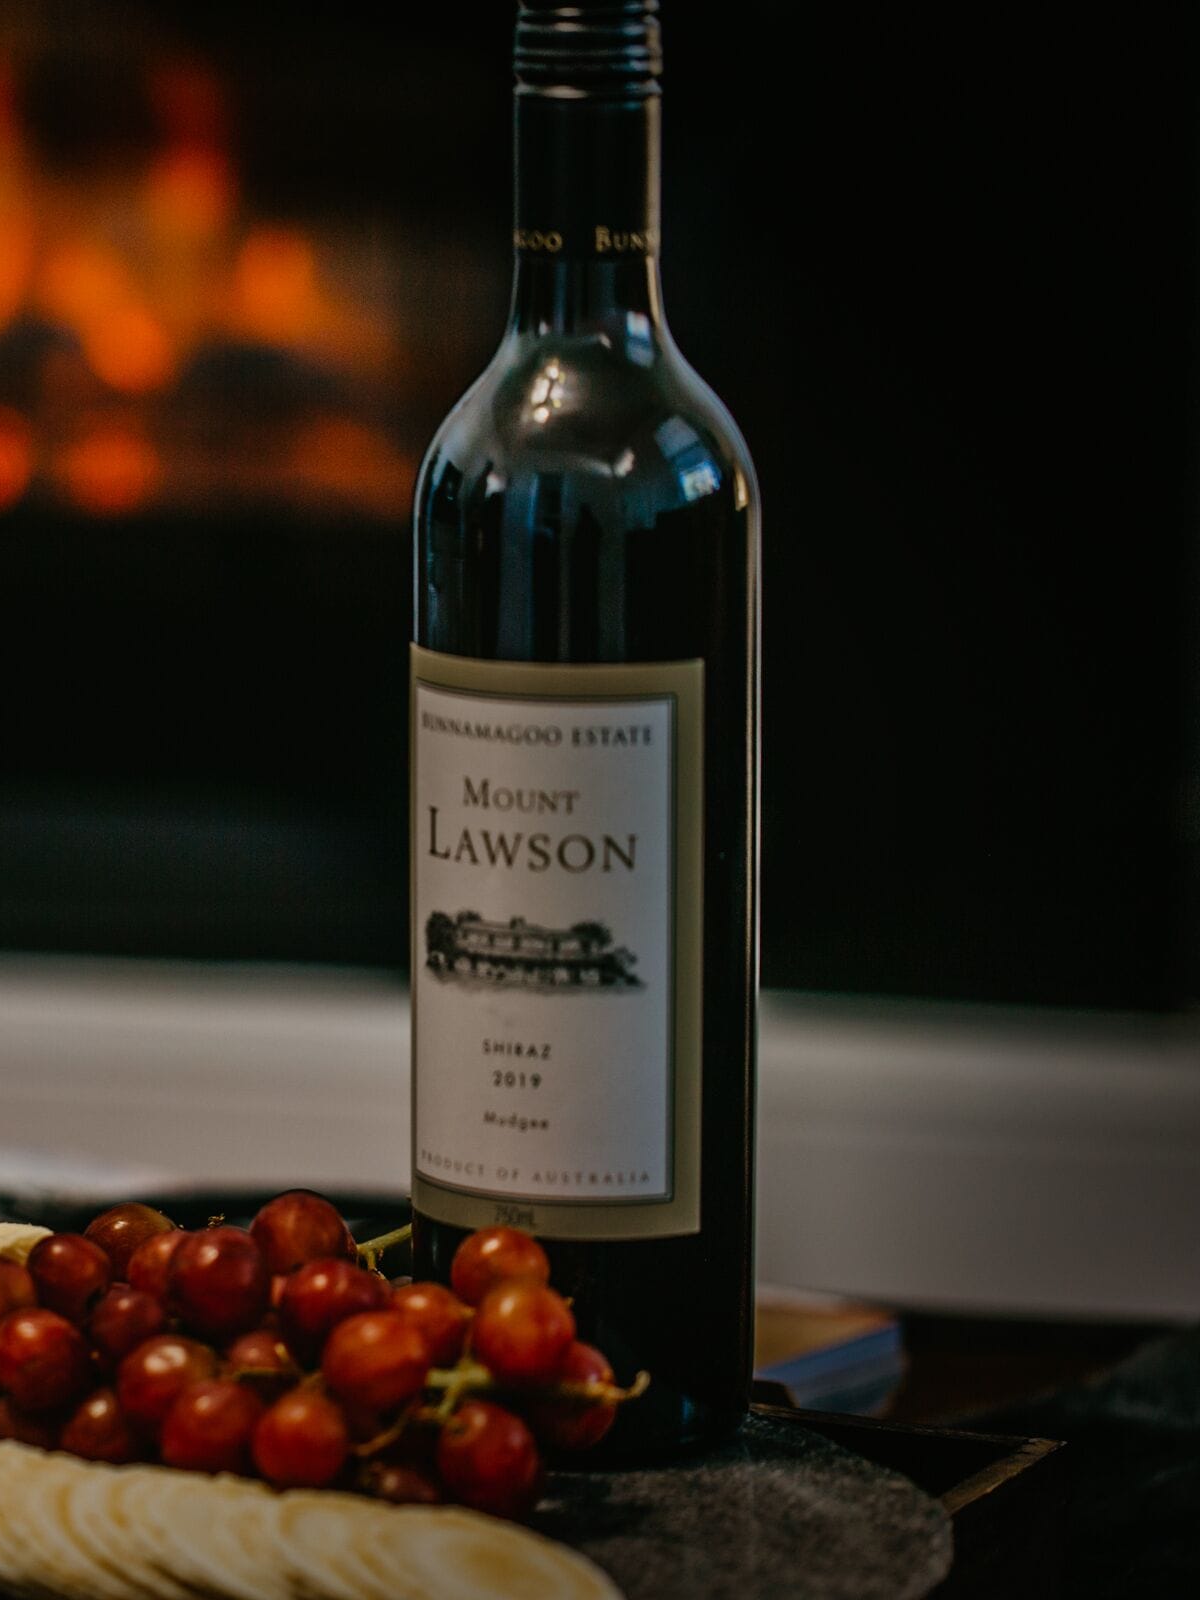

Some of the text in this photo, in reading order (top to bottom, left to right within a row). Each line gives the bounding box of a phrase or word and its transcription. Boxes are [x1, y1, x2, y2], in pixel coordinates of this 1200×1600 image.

[571, 725, 653, 747] ESTATE
[463, 776, 579, 815] MOUNT
[428, 806, 639, 874] LAWSON
[482, 1038, 551, 1061] SHIRAZ
[492, 1070, 542, 1090] 2019
[483, 1110, 549, 1132] Mudgee
[421, 1149, 650, 1186] PRODUCT OF AUSTRALIA
